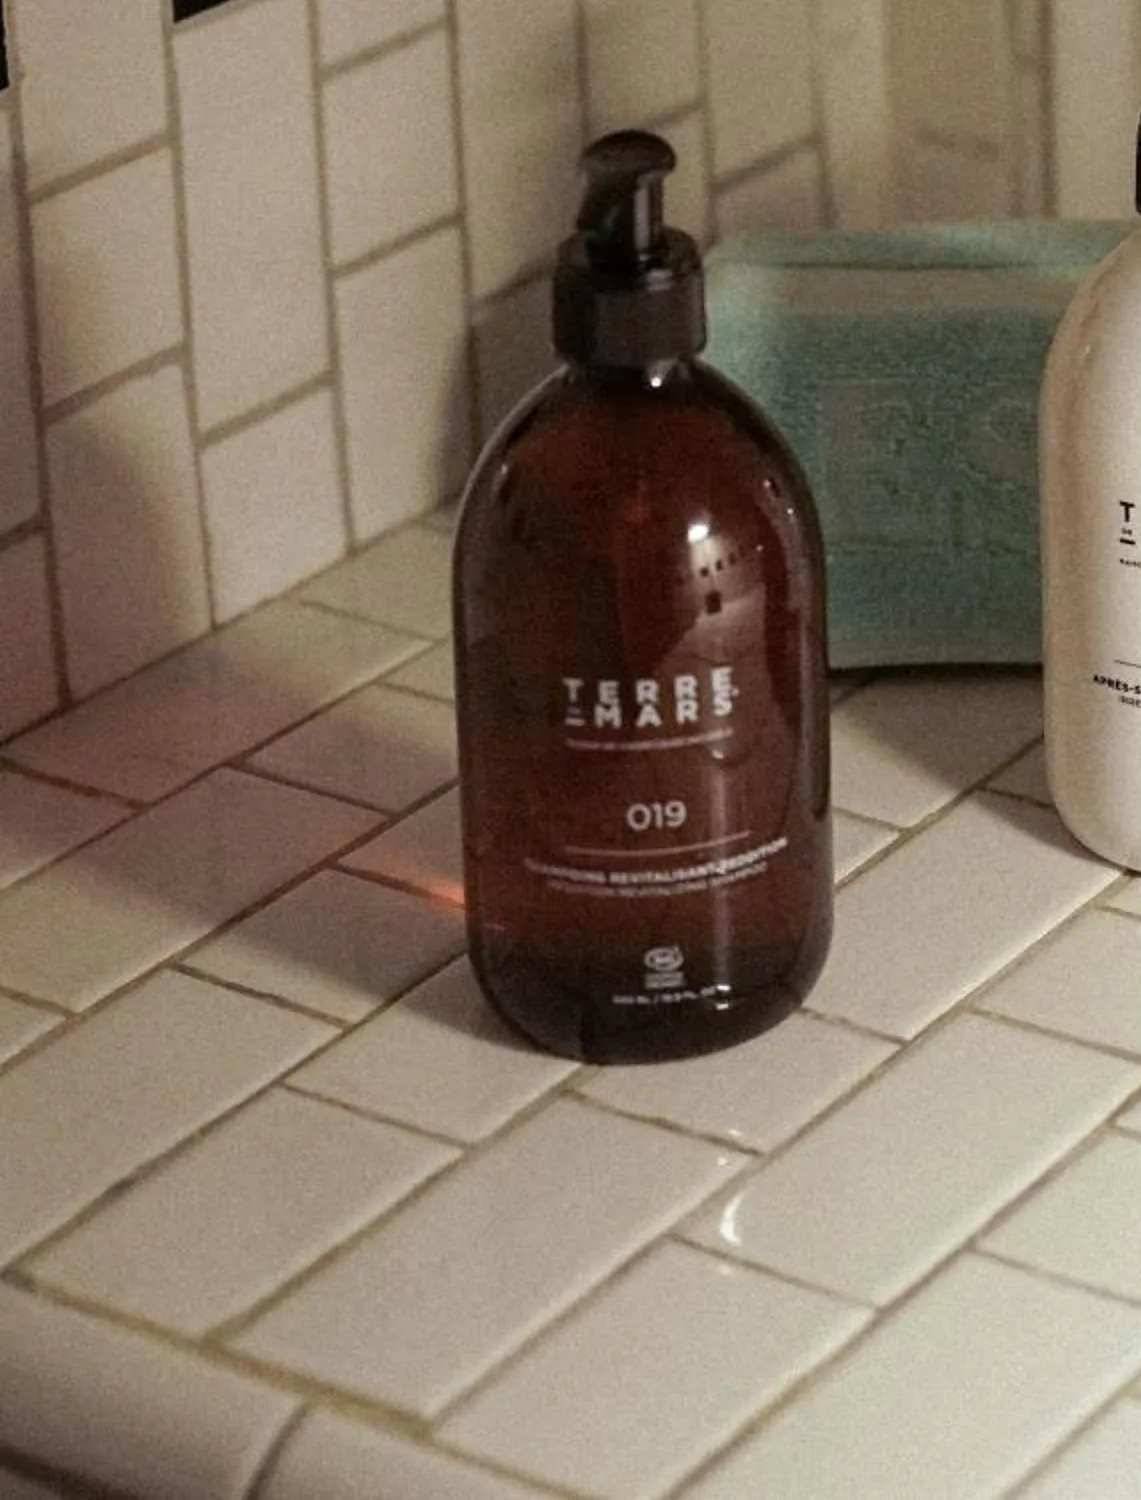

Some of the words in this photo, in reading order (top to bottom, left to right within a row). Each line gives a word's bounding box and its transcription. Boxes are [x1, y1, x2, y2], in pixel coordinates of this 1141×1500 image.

[562, 666, 734, 704] TERRE
[594, 696, 735, 729] MARS
[626, 800, 687, 831] 019
